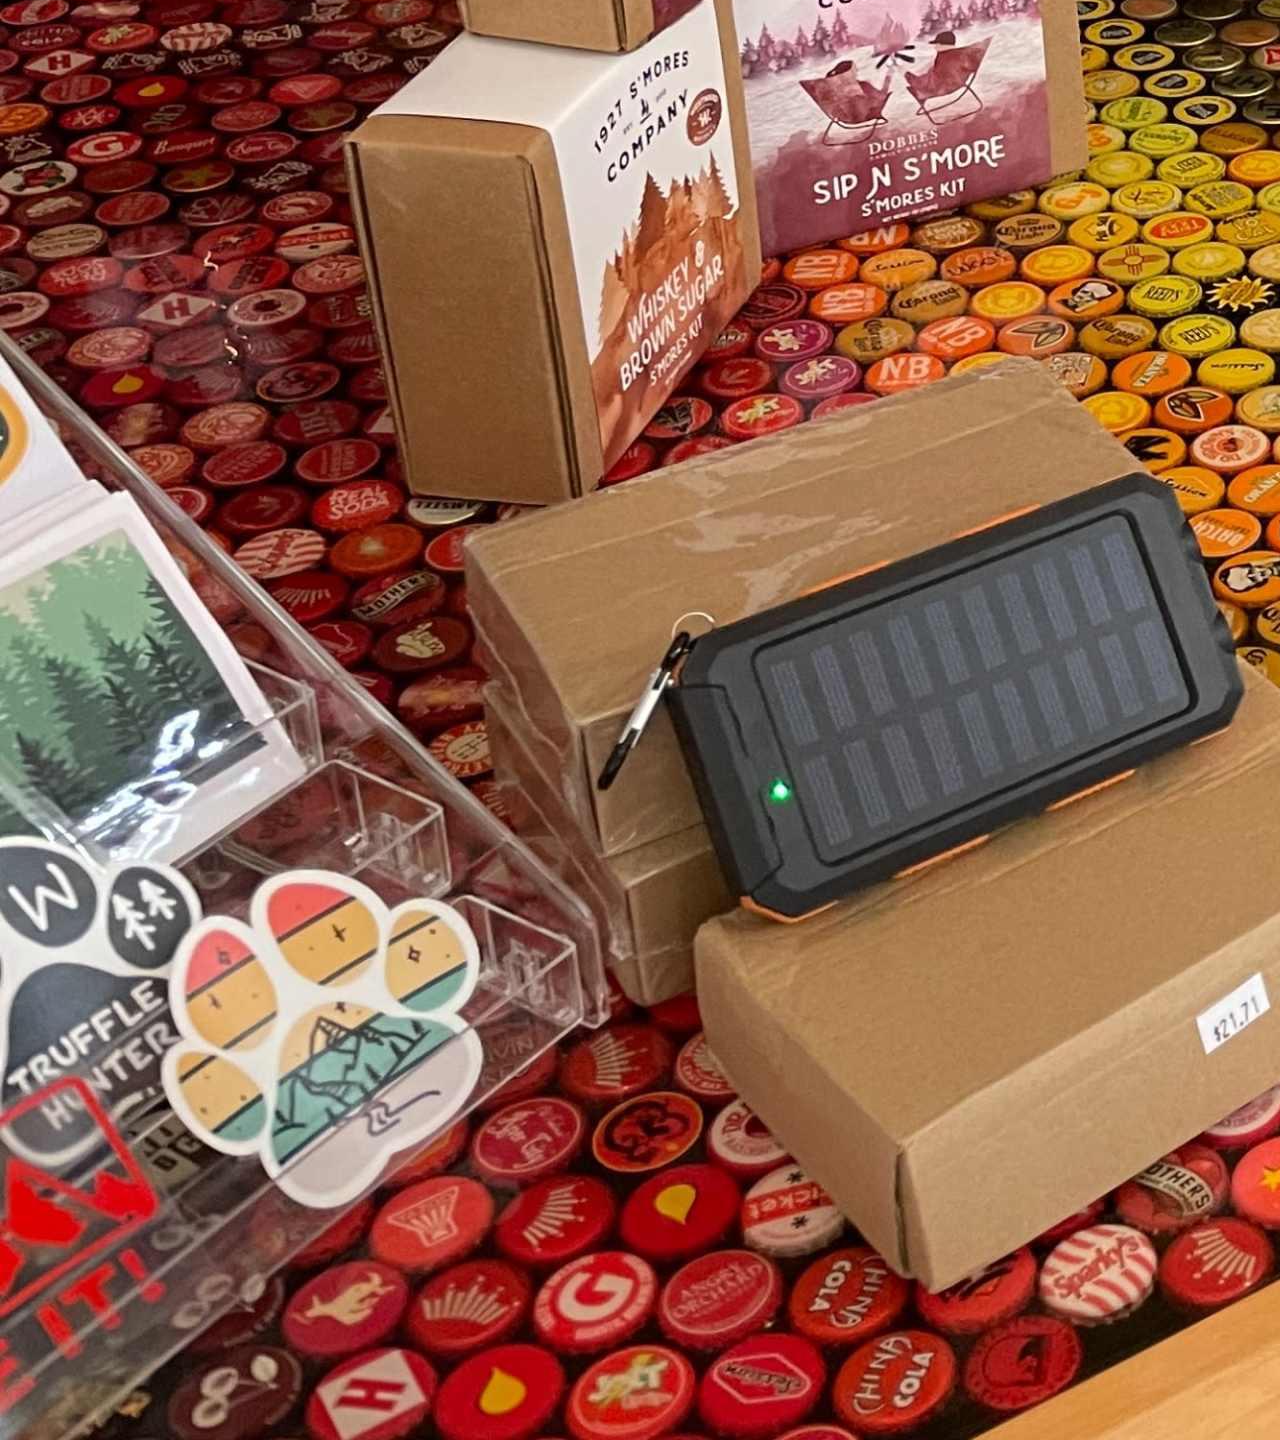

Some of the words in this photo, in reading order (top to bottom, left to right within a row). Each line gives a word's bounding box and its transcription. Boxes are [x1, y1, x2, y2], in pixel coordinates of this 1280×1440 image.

[593, 100, 625, 154] 1927
[628, 50, 690, 99] S'MORES
[606, 87, 690, 183] COMPANY
[868, 128, 939, 157] DOBBES
[812, 172, 859, 205] SIP
[865, 163, 892, 200] N
[903, 134, 1006, 180] S'MORE
[861, 186, 935, 217] S'MORES
[940, 176, 967, 198] KIT
[620, 314, 676, 392] BROWN
[677, 253, 725, 324] SUGAR
[626, 260, 691, 344] WHISKEY
[899, 286, 960, 310] Corona
[650, 342, 689, 387] S'MORES
[880, 356, 932, 380] NB
[328, 483, 380, 506] REAL
[330, 494, 390, 521] SODA
[8, 981, 164, 1096] TRUFFLE
[1213, 995, 1261, 1042] $21.71
[809, 1260, 851, 1312] COLA
[1055, 1232, 1141, 1299] Sparky's
[853, 1336, 913, 1414] CHINA
[893, 1352, 934, 1408] COLA
